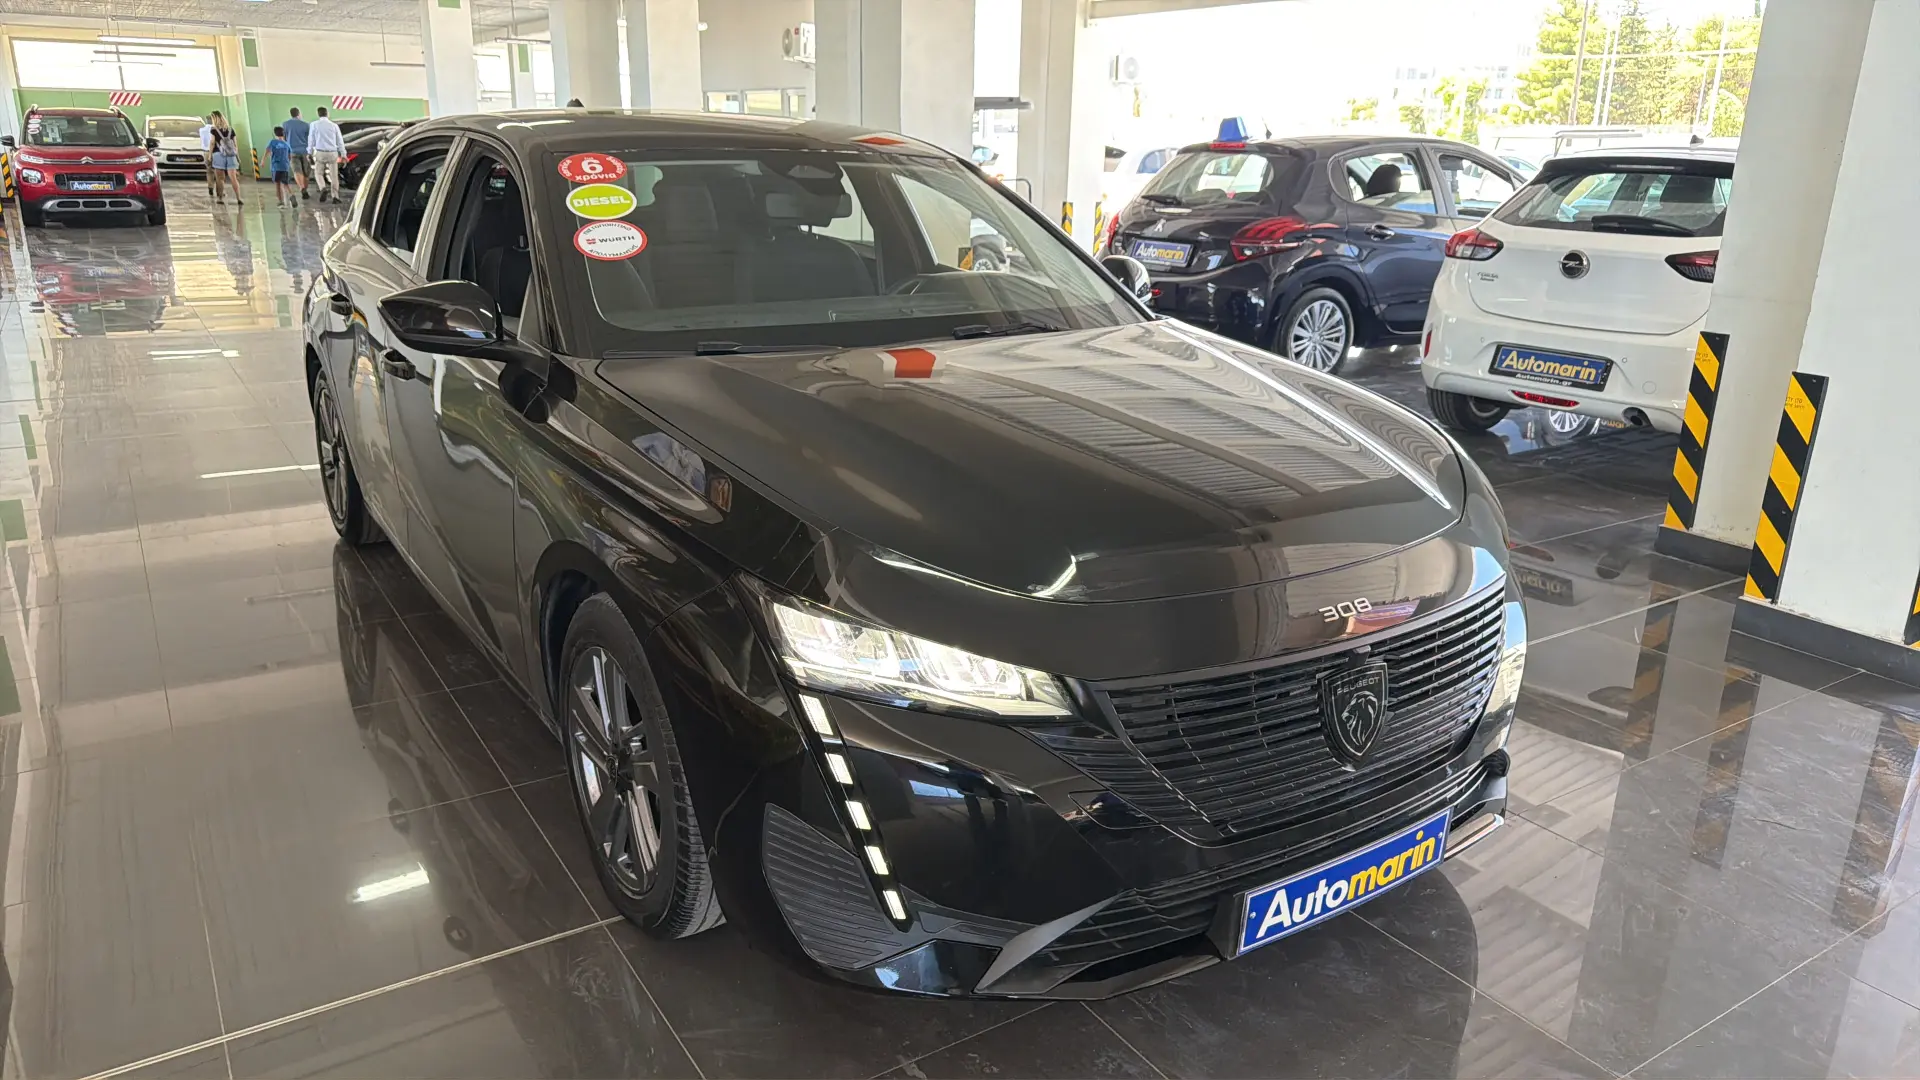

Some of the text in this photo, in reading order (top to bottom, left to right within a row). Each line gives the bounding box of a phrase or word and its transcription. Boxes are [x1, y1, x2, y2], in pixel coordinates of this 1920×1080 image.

[581, 159, 603, 174] 6
[575, 173, 617, 182] χρόνια
[572, 195, 631, 208] DIESEL
[1135, 242, 1185, 260] Automarin
[1501, 350, 1597, 381] Automarin
[1515, 373, 1573, 387] Automarin.gr
[1318, 597, 1373, 622] 308
[1337, 677, 1380, 694] PEUGEOT
[1256, 830, 1436, 939] Automarin
